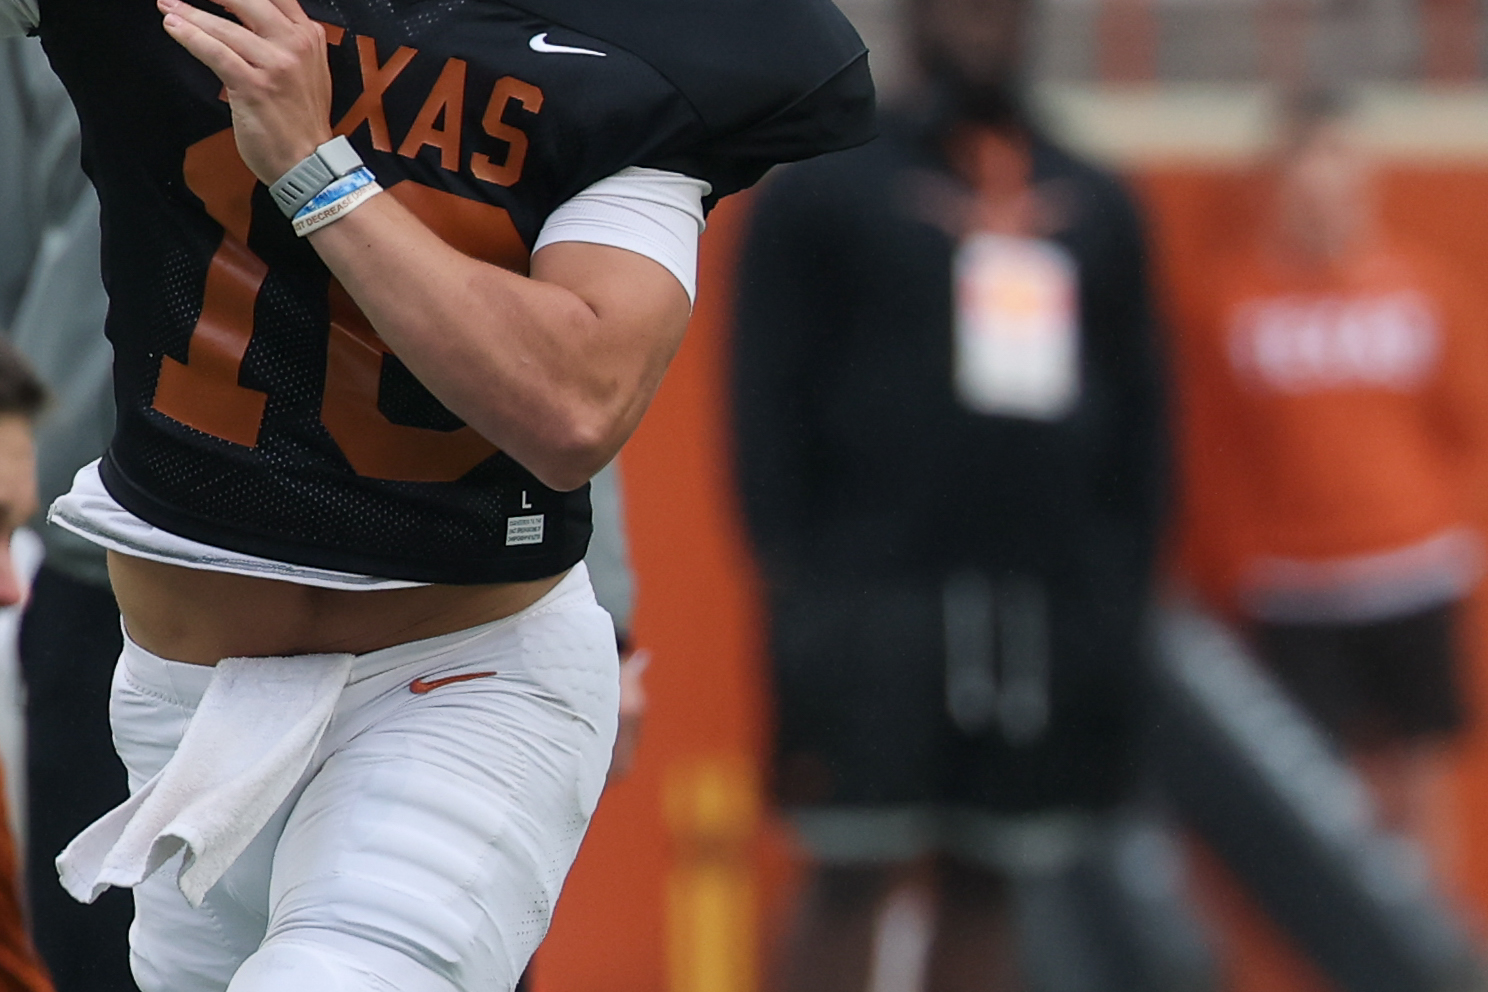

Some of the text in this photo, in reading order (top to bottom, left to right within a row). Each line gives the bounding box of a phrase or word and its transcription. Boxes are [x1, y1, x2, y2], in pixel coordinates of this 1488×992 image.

[219, 18, 544, 188] XAS
[306, 195, 354, 227] DECREASE
[522, 490, 532, 509] L
